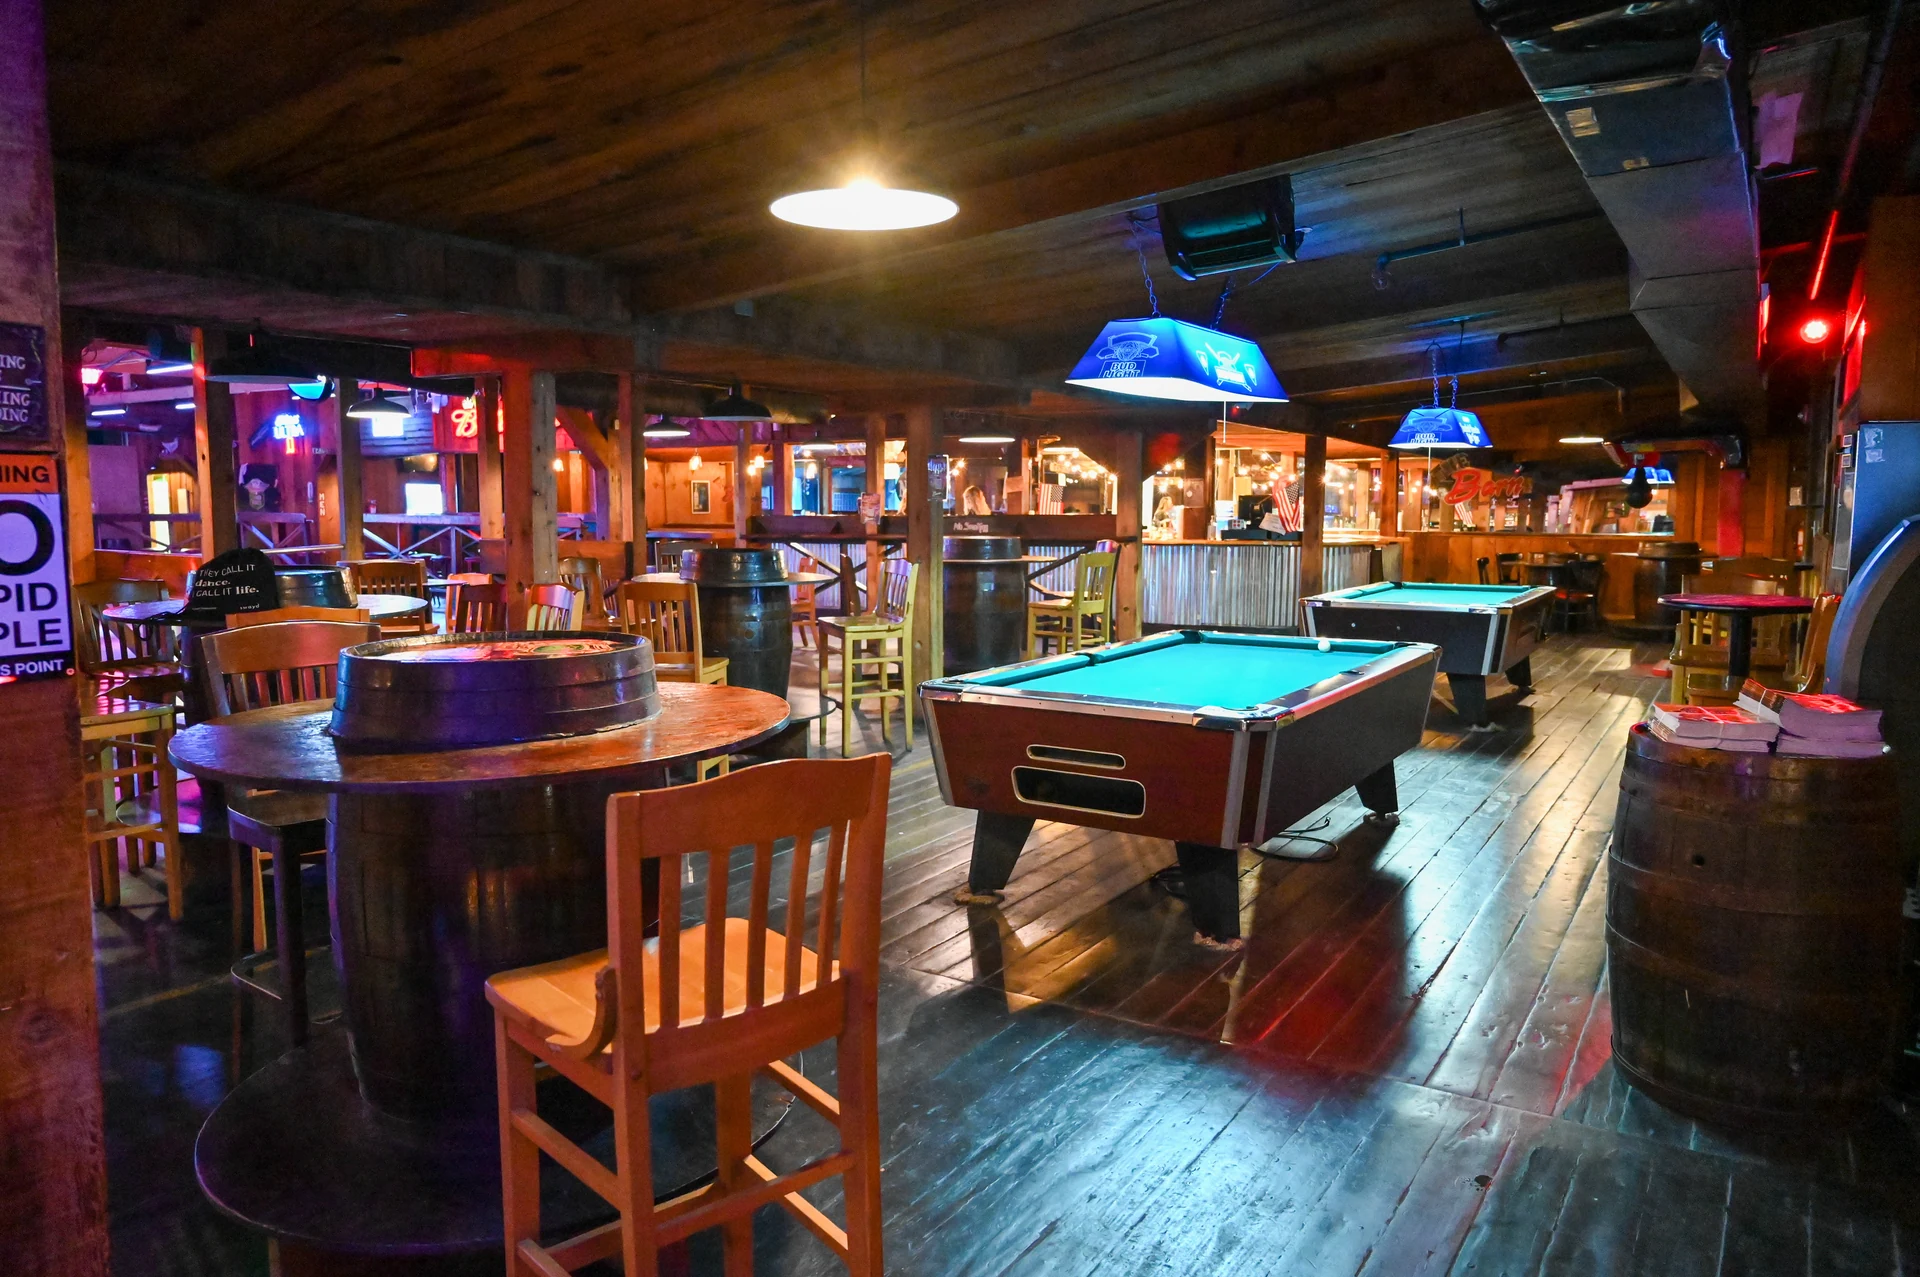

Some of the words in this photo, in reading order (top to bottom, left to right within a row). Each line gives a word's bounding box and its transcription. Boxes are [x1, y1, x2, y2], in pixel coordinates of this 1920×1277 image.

[1103, 369, 1141, 378] LIGHT
[1111, 361, 1137, 371] BUD
[0, 391, 31, 407] ING
[0, 464, 51, 483] ING
[1444, 466, 1524, 505] Barn
[200, 569, 220, 578] THEY
[221, 564, 244, 577] CALL
[246, 563, 256, 572] IT
[195, 579, 231, 587] dance.
[195, 588, 220, 597] CALL
[222, 587, 232, 596] IT
[235, 585, 260, 595] life.
[14, 659, 65, 675] POINT
